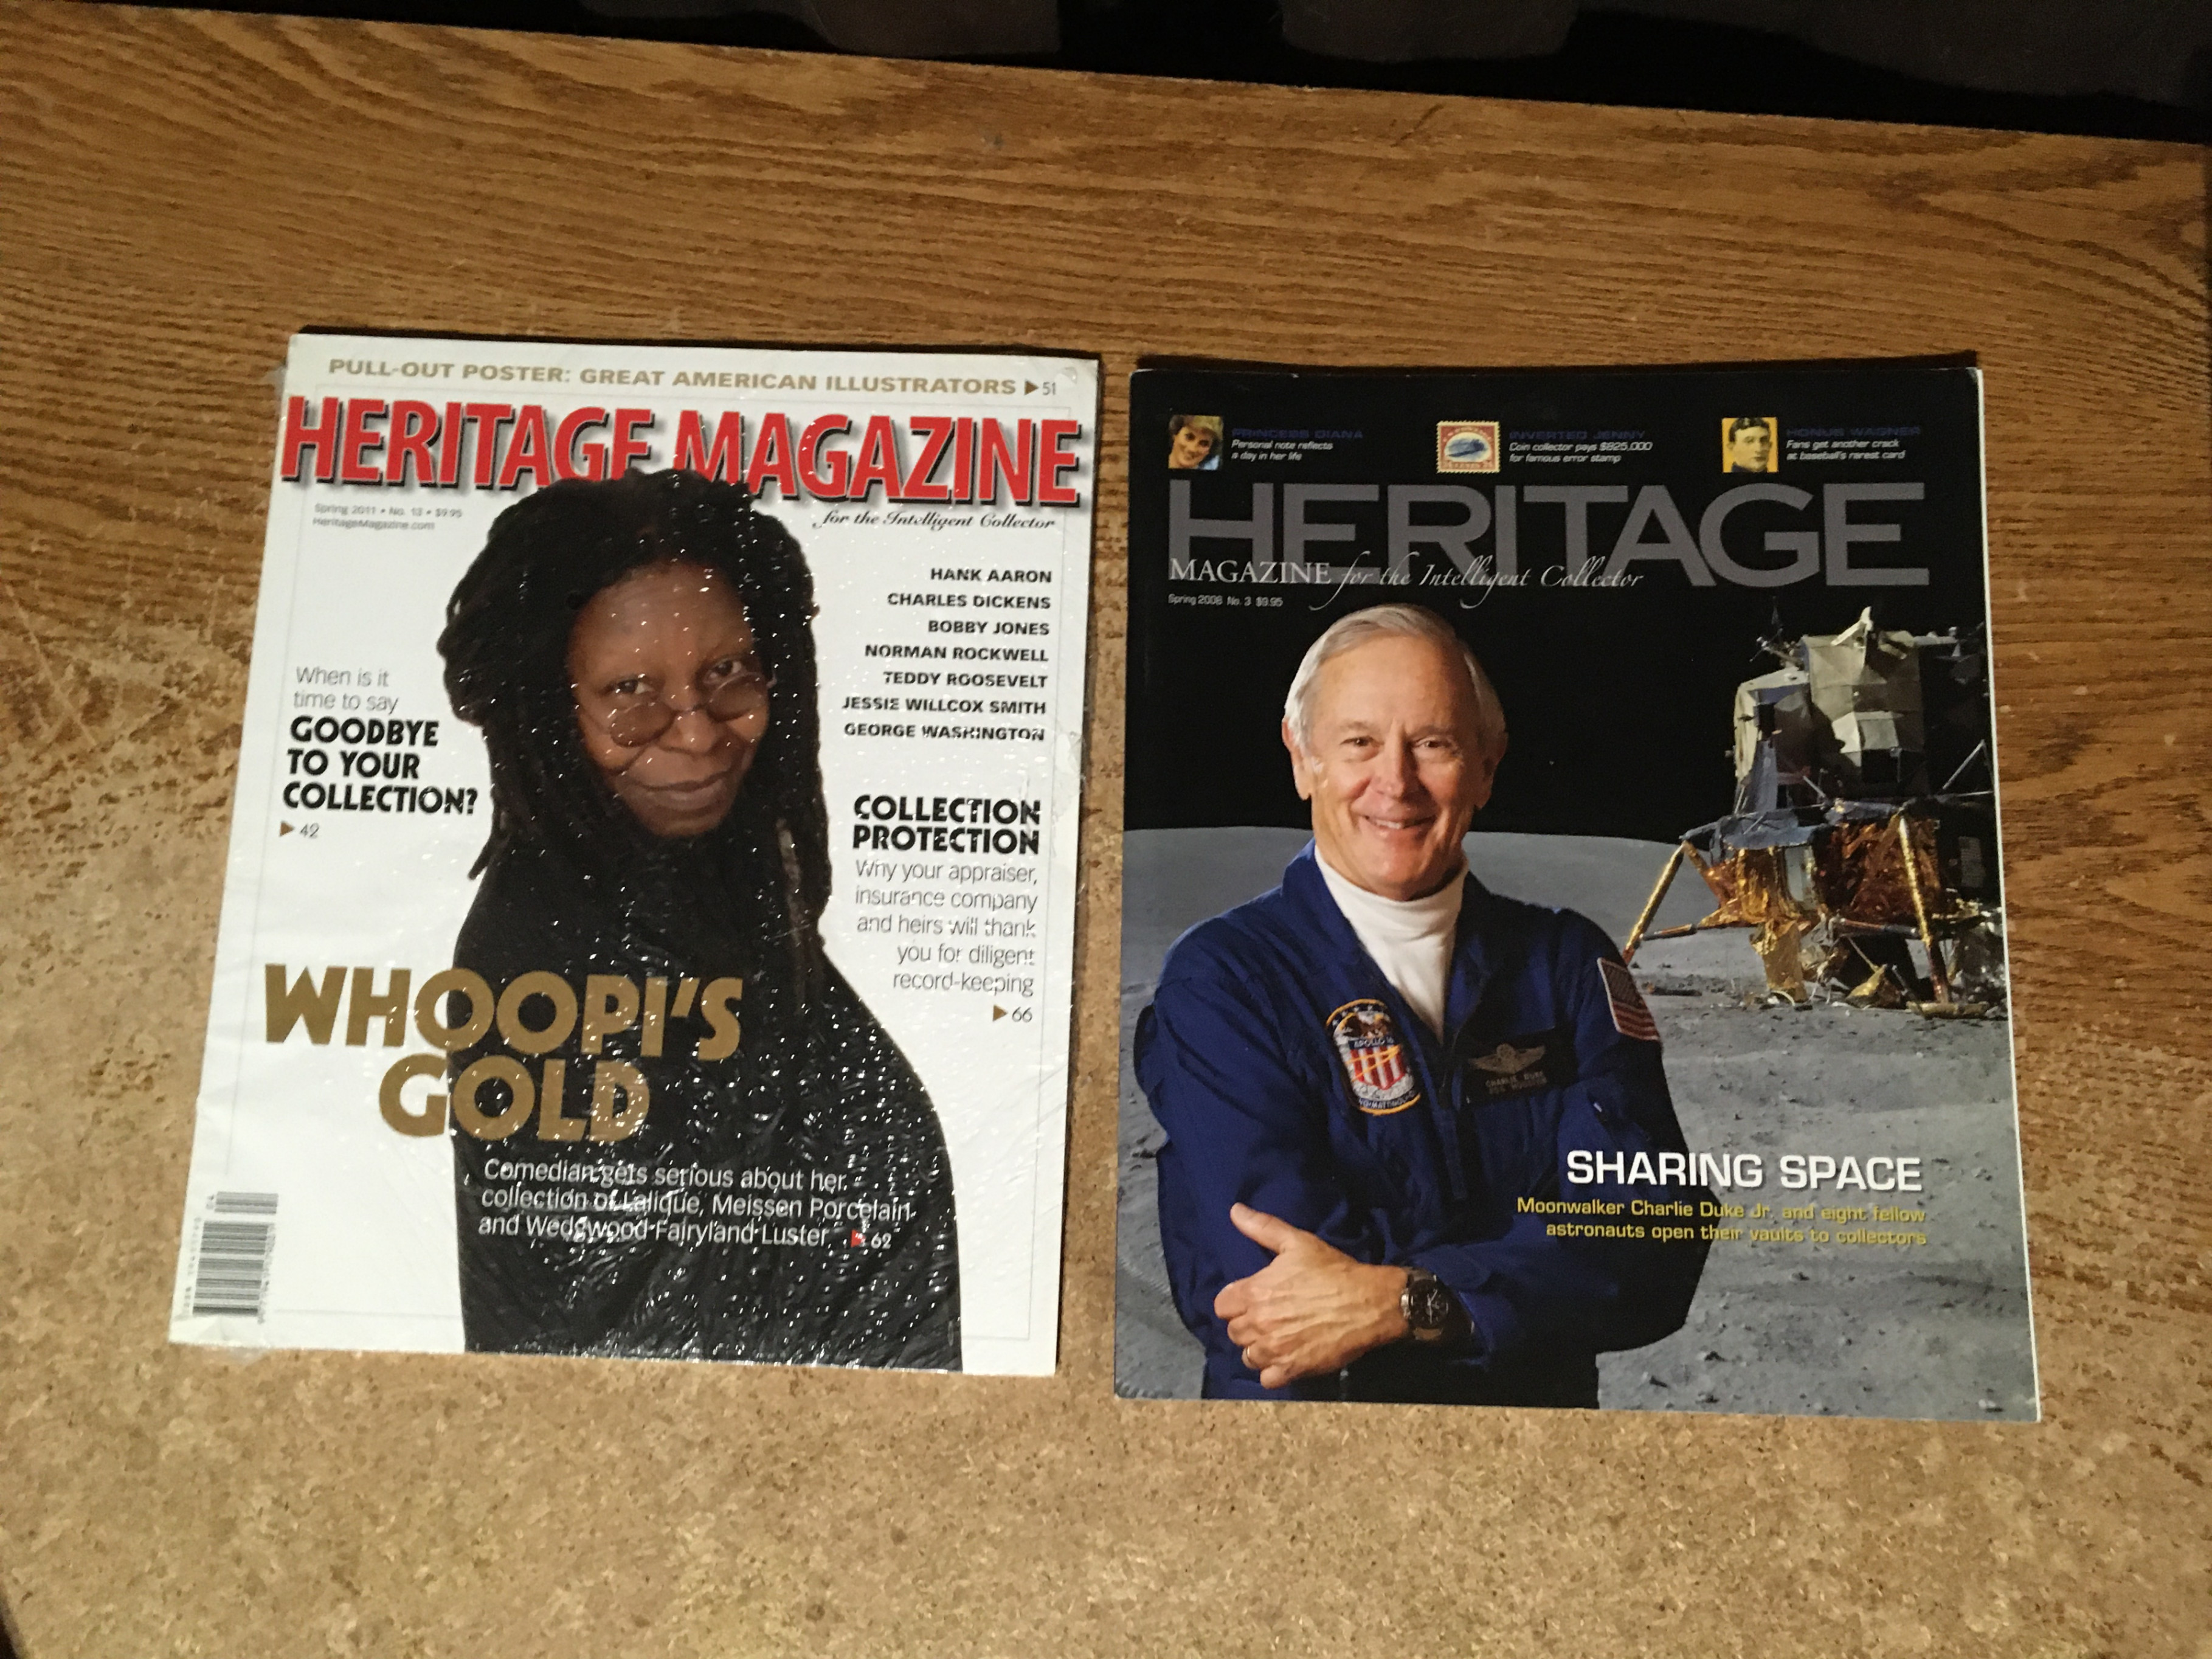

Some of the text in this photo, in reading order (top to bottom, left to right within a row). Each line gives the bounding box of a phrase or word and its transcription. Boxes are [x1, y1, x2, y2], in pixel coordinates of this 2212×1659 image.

[328, 358, 1057, 396] PULL-OUT POSTER: GREAT AMERICAN ILLUSTRATORS 51
[1231, 439, 1333, 450] Personal note reflects
[1314, 429, 1363, 438] DIANA
[1786, 438, 1900, 450] Fans get another crack
[280, 396, 1080, 506] HERITAGE MAGAZINE
[1240, 452, 1257, 462] day
[1258, 452, 1268, 460] in
[1269, 452, 1287, 461] her
[1287, 452, 1303, 462] life
[1509, 442, 1653, 453] Coin collector pays $825,000
[1509, 454, 1524, 463] for
[1525, 454, 1561, 463] famous
[1590, 454, 1622, 464] stamp
[1800, 451, 1847, 460] baseball's
[1848, 451, 1880, 460] rarest
[1882, 450, 1906, 460] card
[314, 503, 348, 516] Spring
[812, 510, 1055, 531] for the Intelligent Collector
[1169, 479, 1929, 587] HERITAGE
[930, 567, 1052, 583] HANK AARON
[1170, 550, 1643, 611] MAGAZINE for the Intelligent Collector
[887, 592, 1051, 609] CHARLES DICKENS
[1168, 594, 1197, 606] Spring
[1244, 597, 1252, 606] 3
[928, 620, 1050, 636] BOBBY JONES
[865, 645, 1049, 662] NORMAN ROCKWELL
[296, 666, 389, 687] When is it
[883, 671, 1048, 688] TEDDY ROOSEVELT
[294, 691, 399, 715] time to say
[842, 696, 1046, 715] JESSIE WILLCOX SMITH
[290, 715, 439, 746] GOODBYE
[844, 722, 1045, 741] GEORGE WASHINGTON
[288, 749, 420, 779] TO YOUR
[283, 781, 479, 814] COLLECTION?
[853, 794, 1041, 825] COLLECTION
[299, 823, 319, 839] 42
[852, 825, 1039, 854] PROTECTION
[855, 859, 1038, 885] Why your appraiser,
[855, 885, 1038, 914] insurance company
[857, 914, 1036, 938] and heirs will thank
[897, 944, 1035, 969] you for diligent
[893, 972, 1034, 997] record-keeping
[264, 963, 744, 1061] WHOOPI'S
[1011, 1006, 1032, 1022] 66
[379, 1053, 651, 1143] GOLD
[485, 1158, 845, 1191] Comedian gets serious about her
[1566, 1149, 1923, 1191] SHARING SPACE
[482, 1186, 911, 1221] collection of Lalique, Meissen Porcelain
[1516, 1196, 1926, 1225] Moonwalker Charlie Duke Jr. and eight fellow
[479, 1214, 519, 1235] and
[761, 1223, 831, 1247] Luster
[871, 1233, 891, 1249] 62
[1546, 1222, 1926, 1245] astronauts open their vaults to collectors
